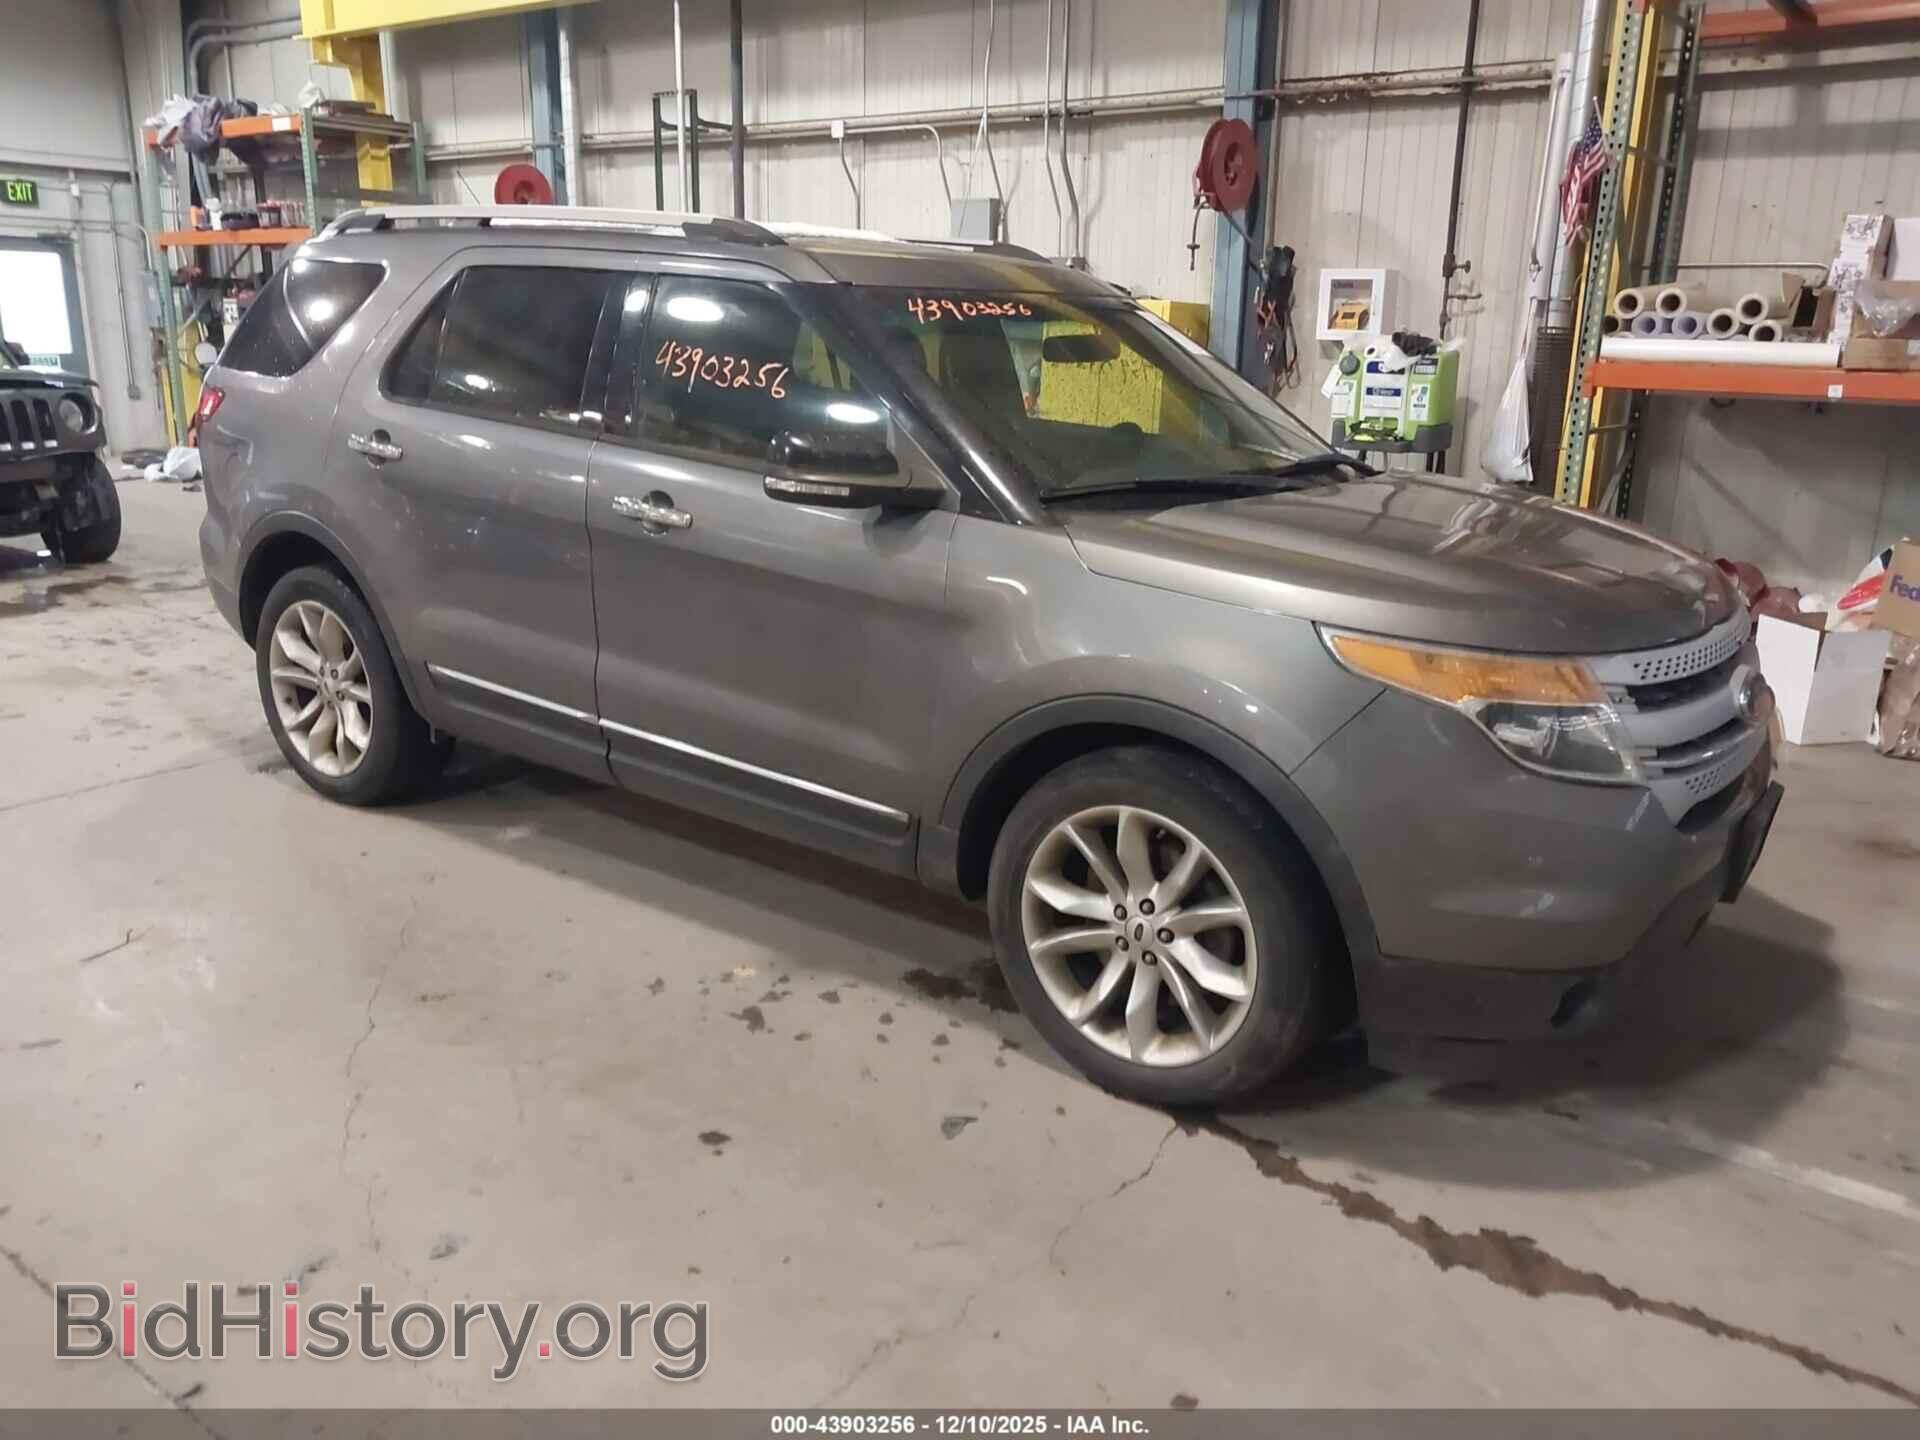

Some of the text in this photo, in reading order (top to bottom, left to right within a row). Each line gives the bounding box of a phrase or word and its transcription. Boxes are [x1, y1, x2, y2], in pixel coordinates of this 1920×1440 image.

[7, 181, 33, 202] EXIT
[906, 297, 1032, 325] 43903256
[655, 340, 789, 399] 43903256
